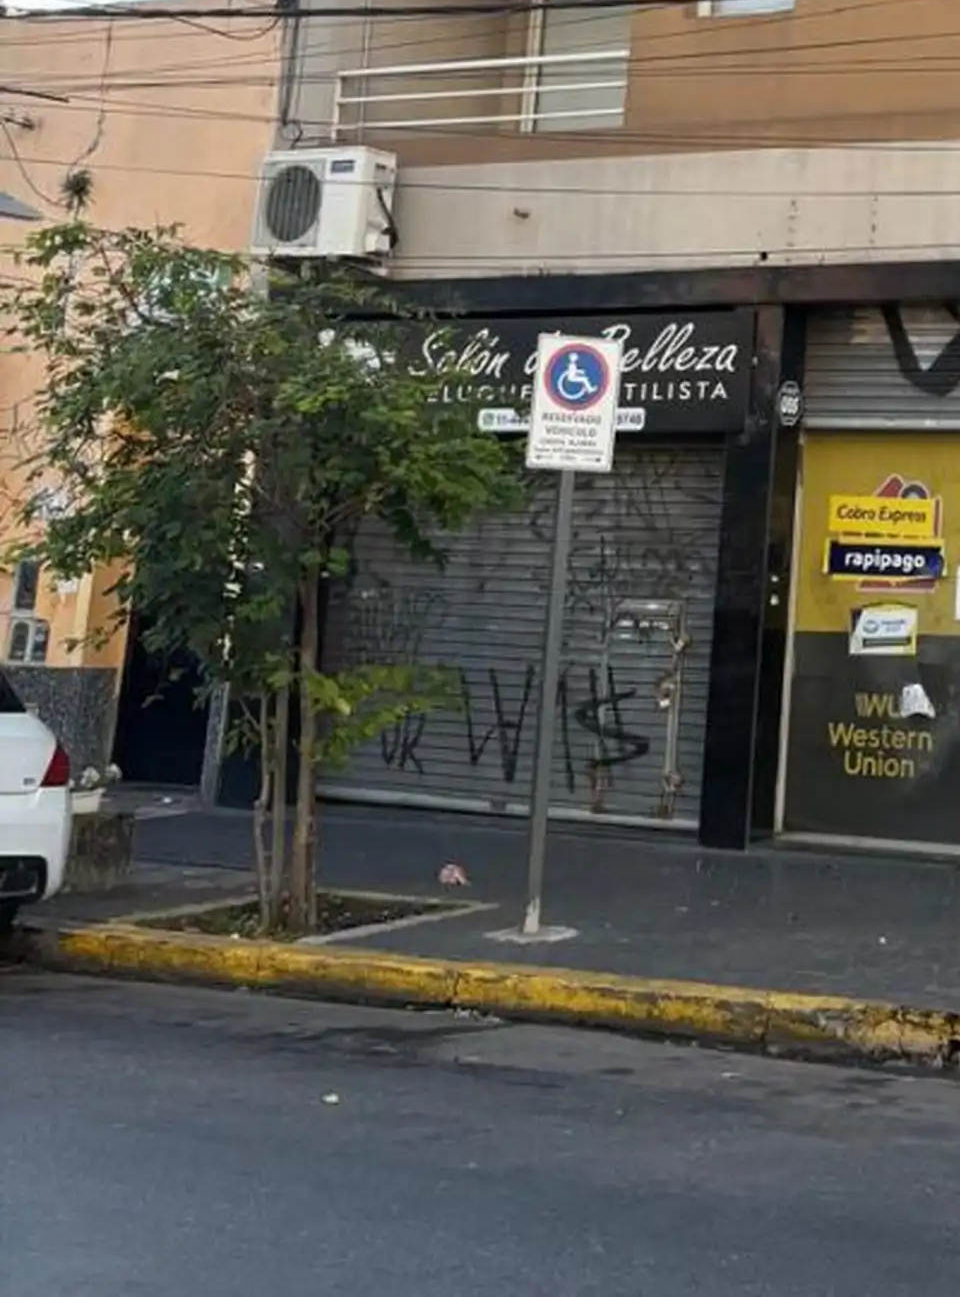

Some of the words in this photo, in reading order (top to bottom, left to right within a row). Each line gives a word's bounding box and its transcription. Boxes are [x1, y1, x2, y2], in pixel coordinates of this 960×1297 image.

[623, 382, 728, 401] TILISTA
[836, 504, 876, 520] Cobro
[878, 506, 927, 525] Express
[844, 548, 925, 573] rapipago
[828, 721, 933, 750] Western
[843, 750, 915, 779] Union
